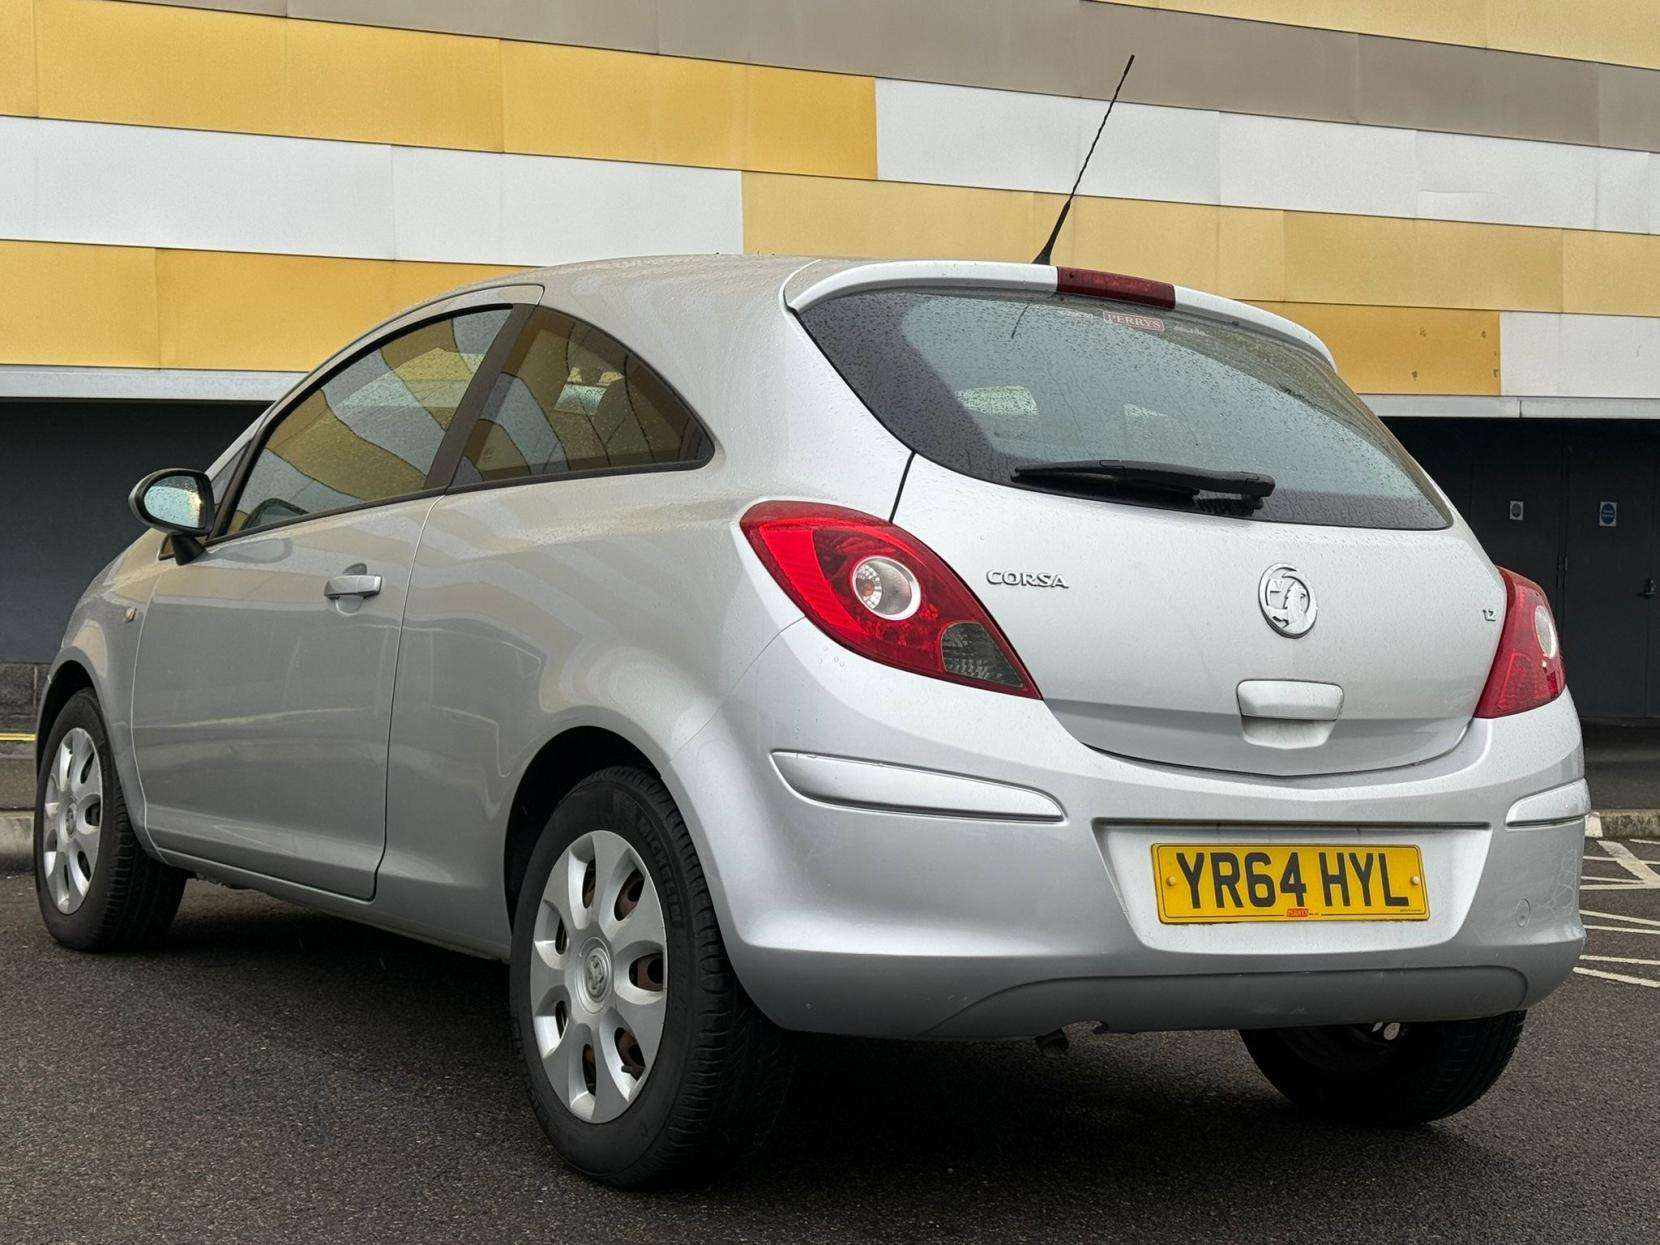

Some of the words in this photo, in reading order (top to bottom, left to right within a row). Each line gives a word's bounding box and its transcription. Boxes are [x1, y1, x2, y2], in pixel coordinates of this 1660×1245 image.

[1107, 313, 1162, 329] PERRYS
[986, 569, 1070, 589] CORSA
[1176, 851, 1307, 909] YR64
[1318, 851, 1409, 908] HYL
